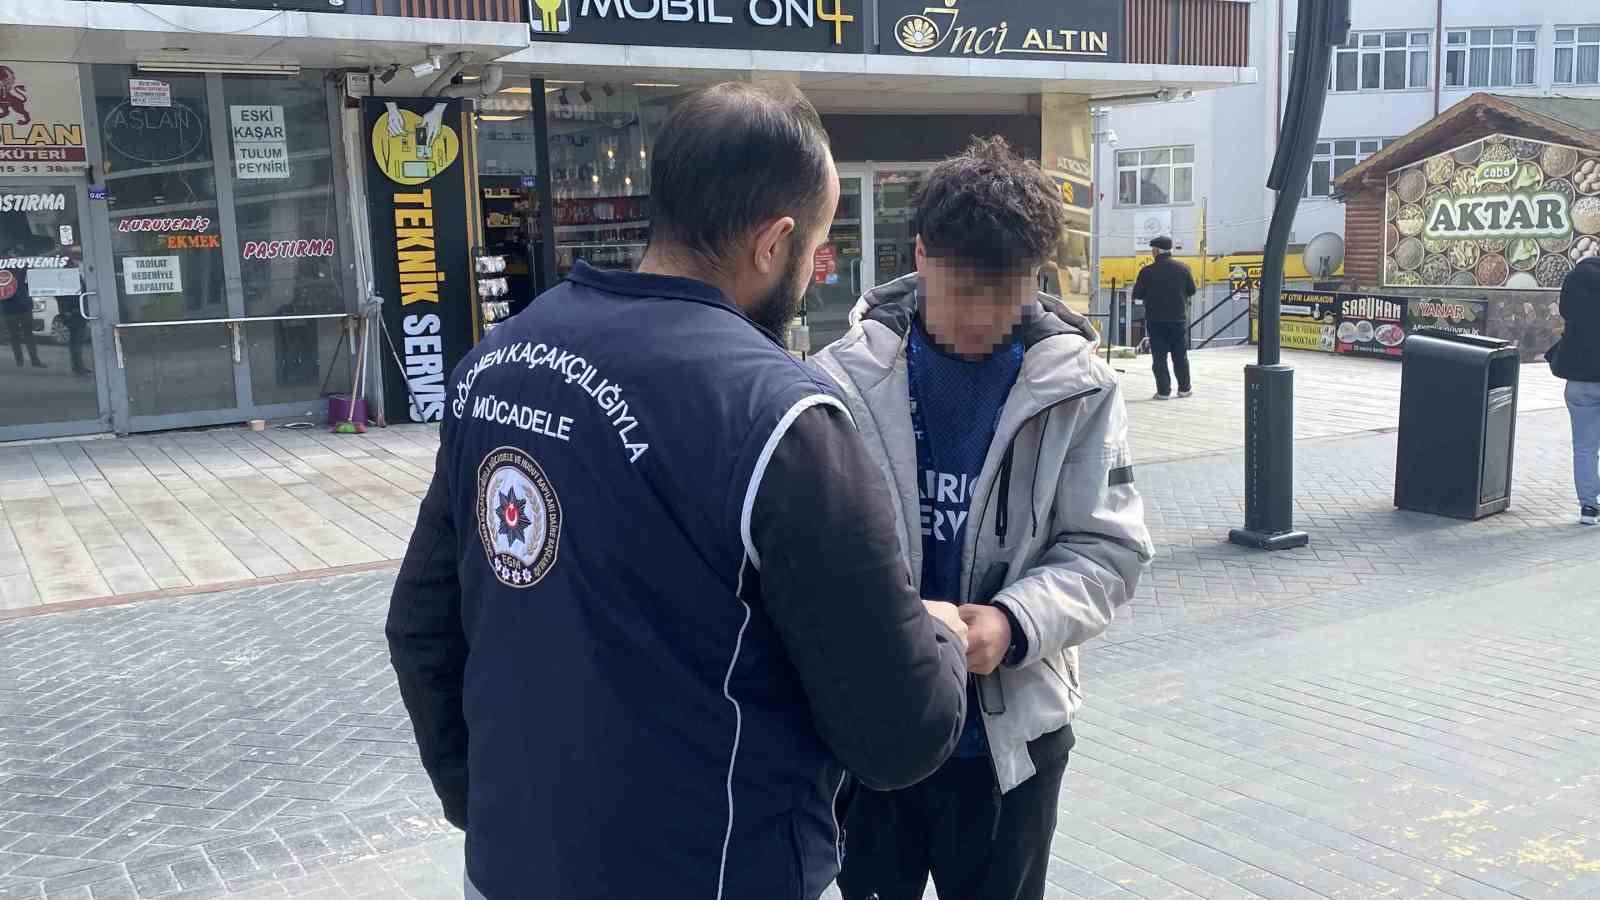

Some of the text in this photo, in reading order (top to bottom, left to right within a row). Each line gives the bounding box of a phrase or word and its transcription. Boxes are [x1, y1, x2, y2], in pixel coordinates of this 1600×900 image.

[1022, 28, 1107, 52] ALTIN
[241, 107, 273, 122] ESKİ
[0, 124, 82, 145] LAN
[234, 126, 283, 140] KAŞAR
[240, 148, 281, 158] TULUM
[239, 160, 287, 173] PEYNİRİ
[119, 216, 210, 232] KURUYEMİŞ
[1428, 197, 1566, 233] AKTAR
[167, 235, 220, 249] EKMEK
[243, 239, 335, 259] PASTIRMA
[393, 188, 447, 423] TEKNİK SERVİS
[1342, 297, 1401, 320] SARUHAN
[1420, 303, 1465, 319] YANAR
[505, 342, 649, 464] KAÇAKÇILIĞIYLA
[472, 395, 574, 441] MÜCADELE
[502, 554, 521, 570] EGM
